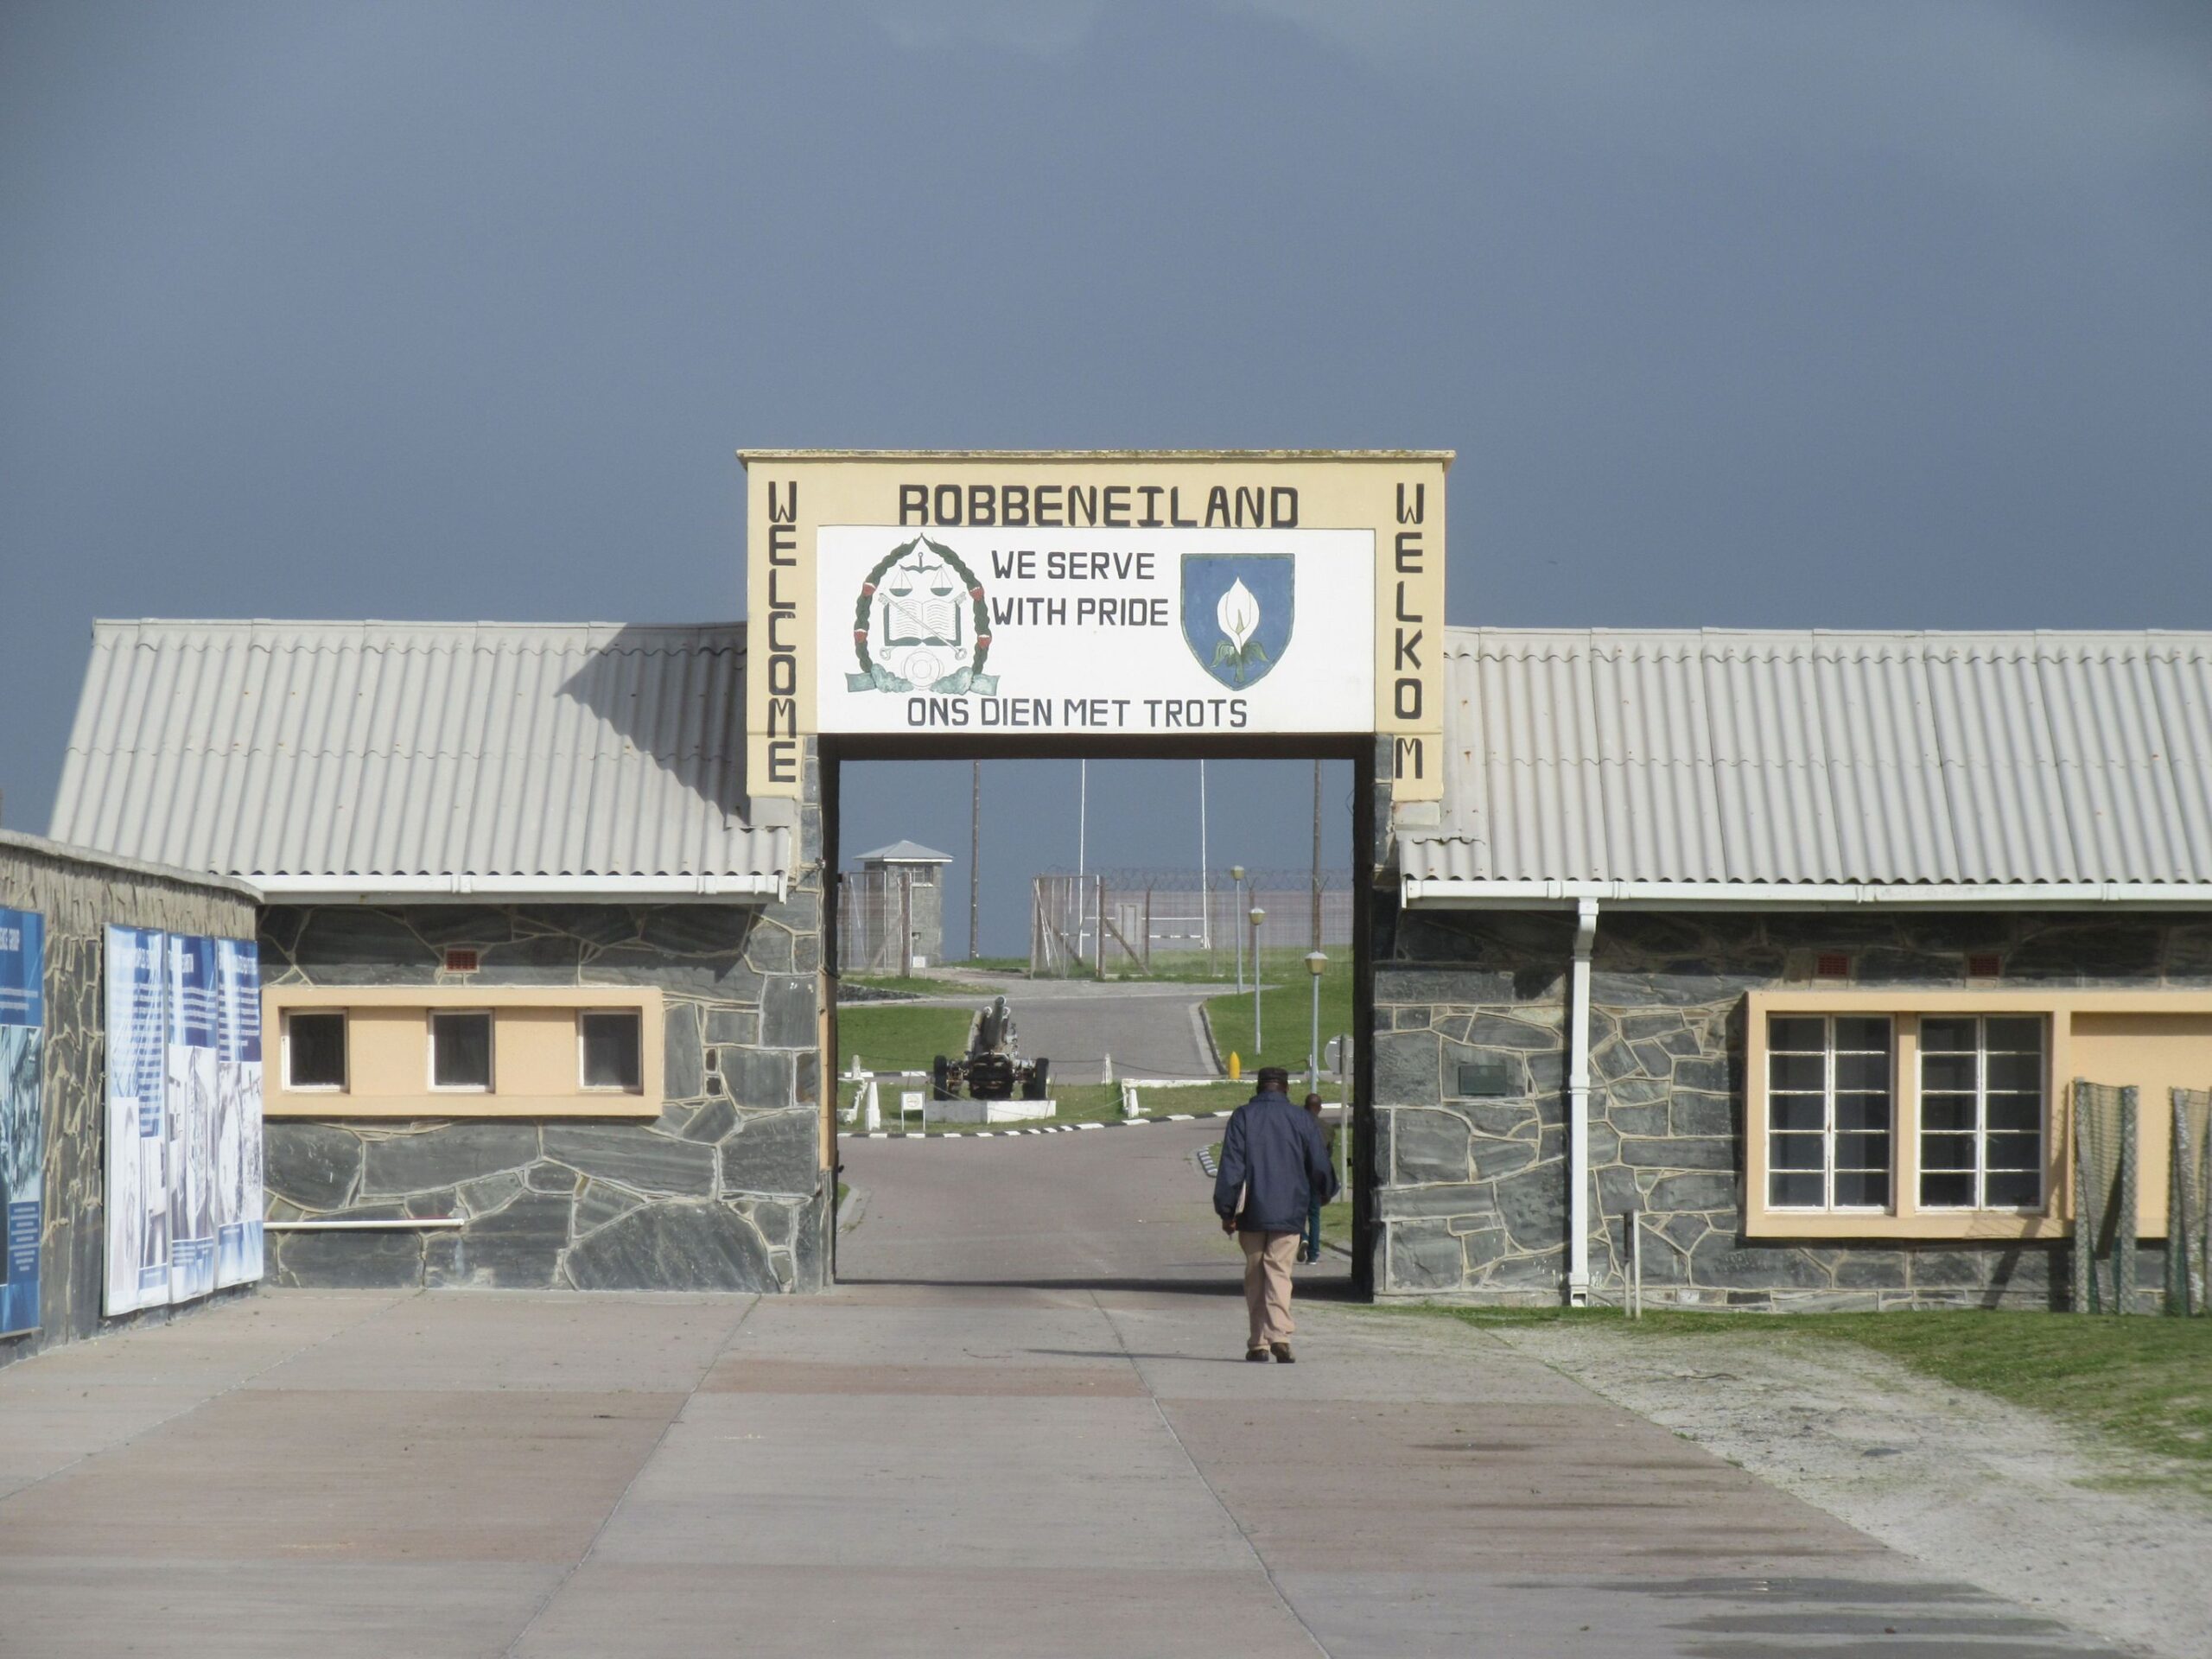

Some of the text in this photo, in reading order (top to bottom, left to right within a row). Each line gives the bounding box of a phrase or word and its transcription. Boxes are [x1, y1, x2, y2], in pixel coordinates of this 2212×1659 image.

[899, 484, 1299, 528] ROBBENEILAND
[991, 550, 1155, 580] WE SERVE
[991, 597, 1169, 626] WITH PRIDE
[767, 480, 798, 783] WELCOME
[1395, 482, 1425, 780] WELKOM
[907, 697, 1248, 728] ONS DIEN MET TROTS
